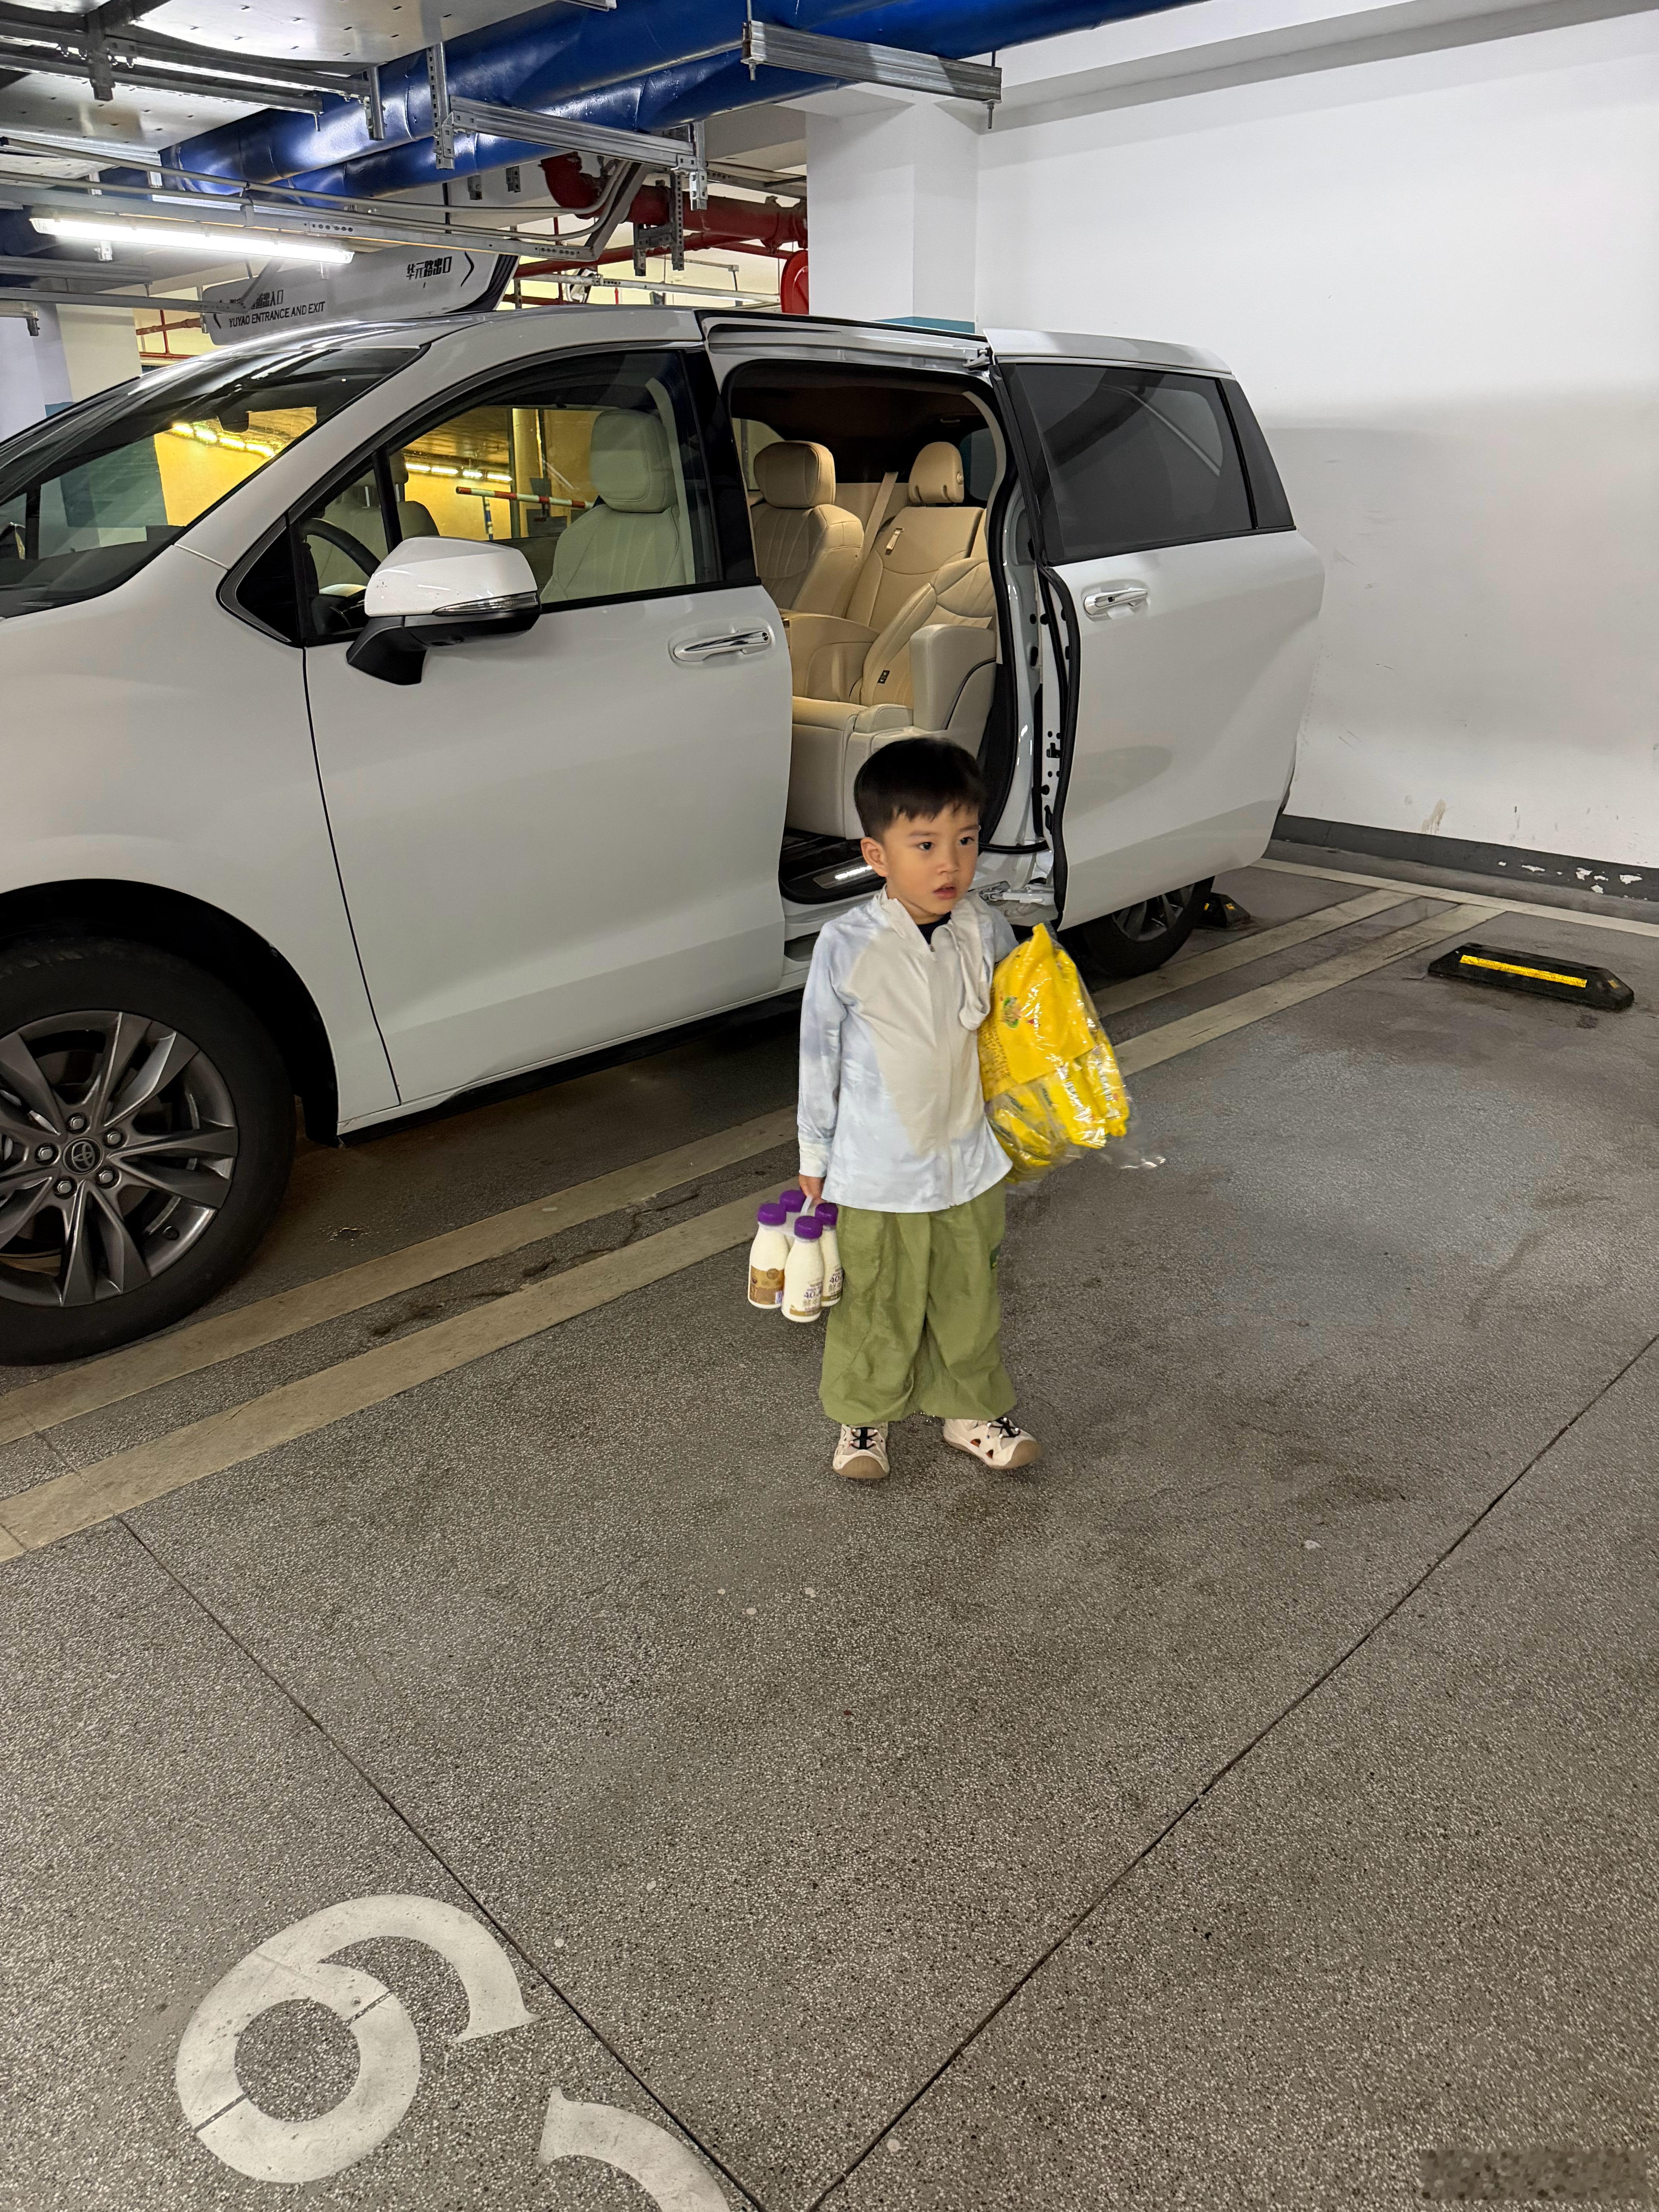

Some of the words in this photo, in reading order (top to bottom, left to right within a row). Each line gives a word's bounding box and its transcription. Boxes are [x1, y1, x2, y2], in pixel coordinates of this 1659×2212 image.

[406, 256, 452, 280] 华元路出口
[229, 315, 250, 328] YUYAO
[252, 308, 290, 323] ENTRANCE
[291, 304, 307, 317] AND
[308, 301, 325, 313] EXIT
